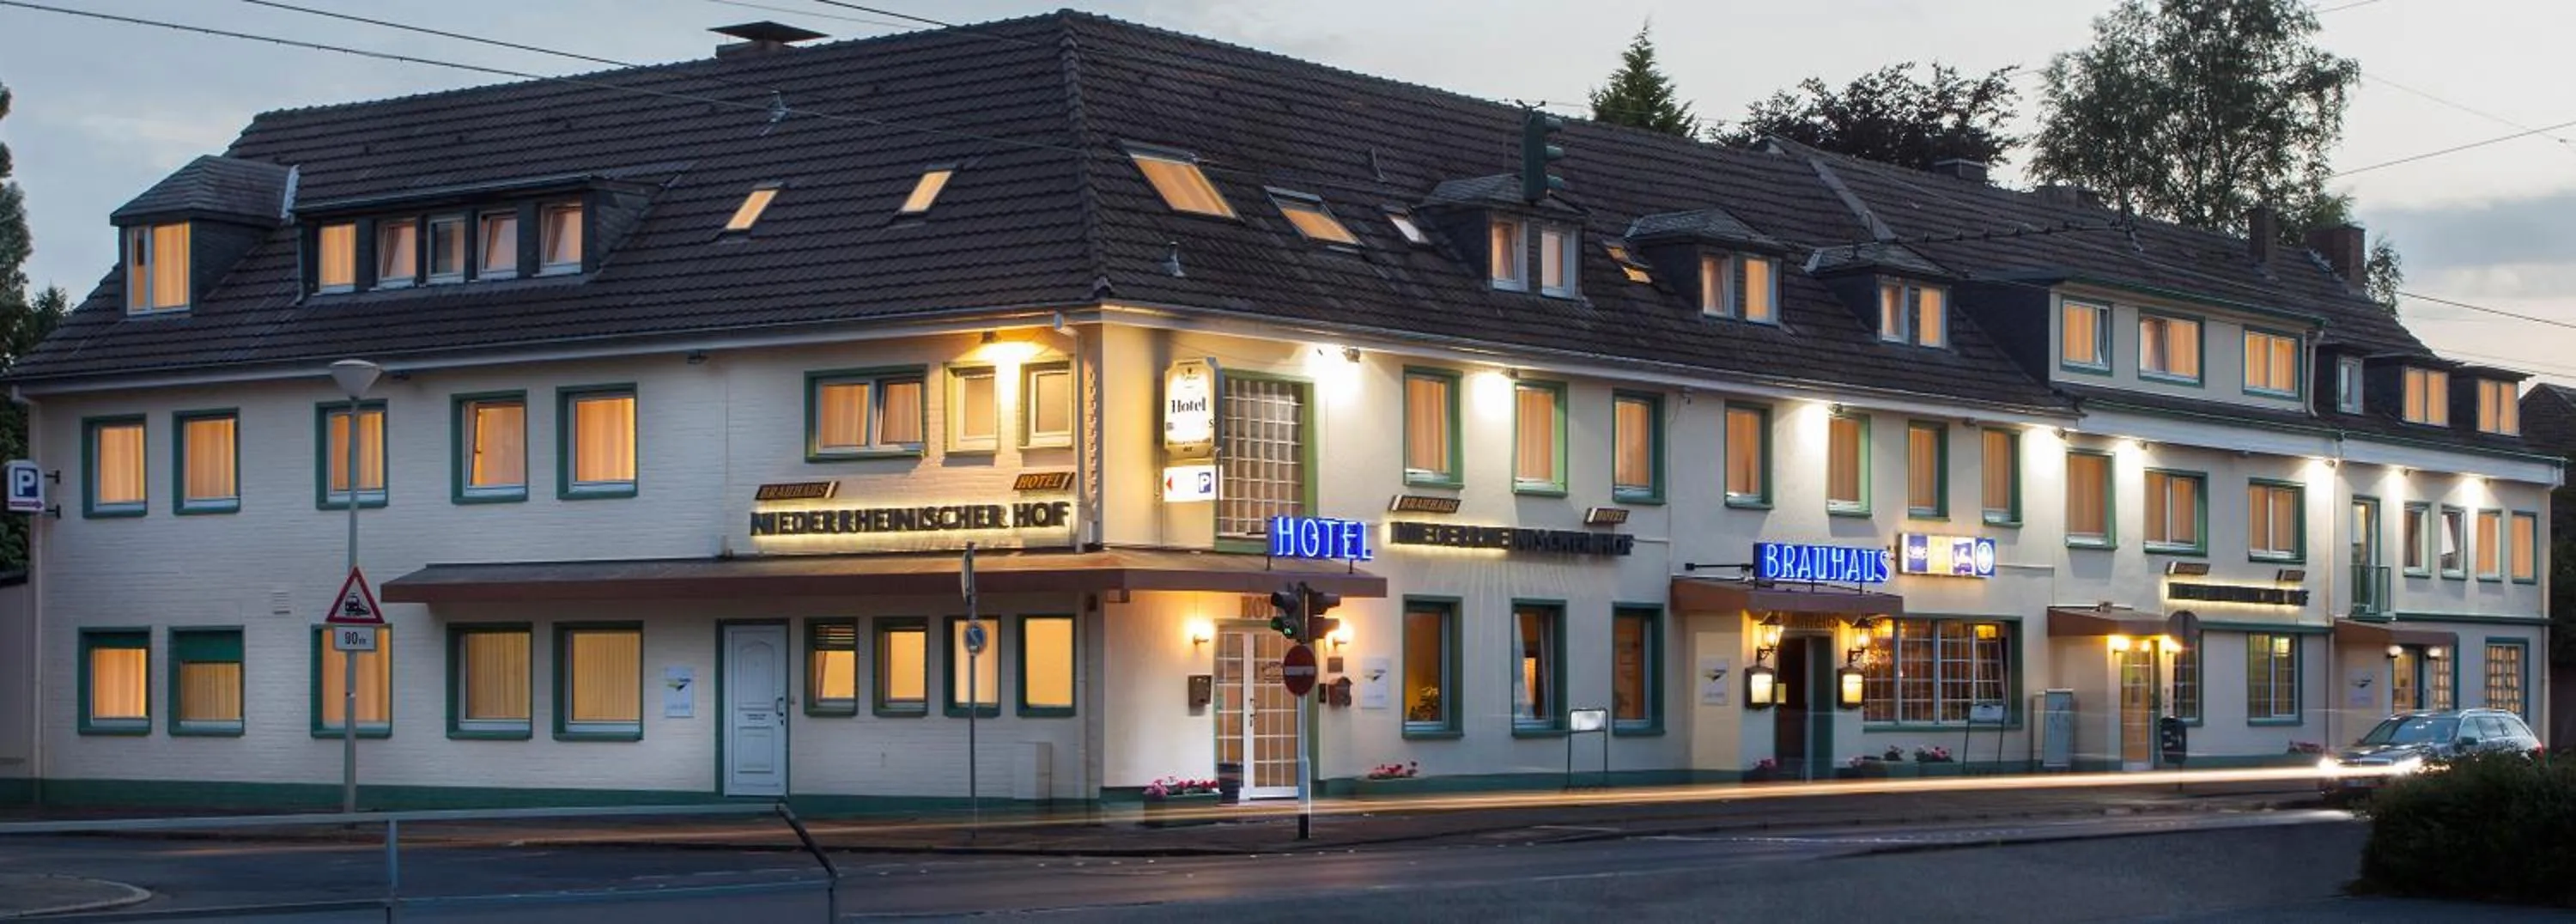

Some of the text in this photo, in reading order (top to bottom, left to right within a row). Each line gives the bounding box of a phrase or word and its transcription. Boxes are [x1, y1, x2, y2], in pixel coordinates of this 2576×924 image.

[1171, 396, 1206, 413] Hotel
[17, 470, 35, 495] P
[1017, 475, 1060, 489] HOTEL
[1200, 474, 1210, 492] P
[750, 502, 1070, 536] NIEDERRHEINISCHER HOF
[1276, 517, 1375, 559] HOTEL
[1765, 544, 1890, 581] BRAUHAUS
